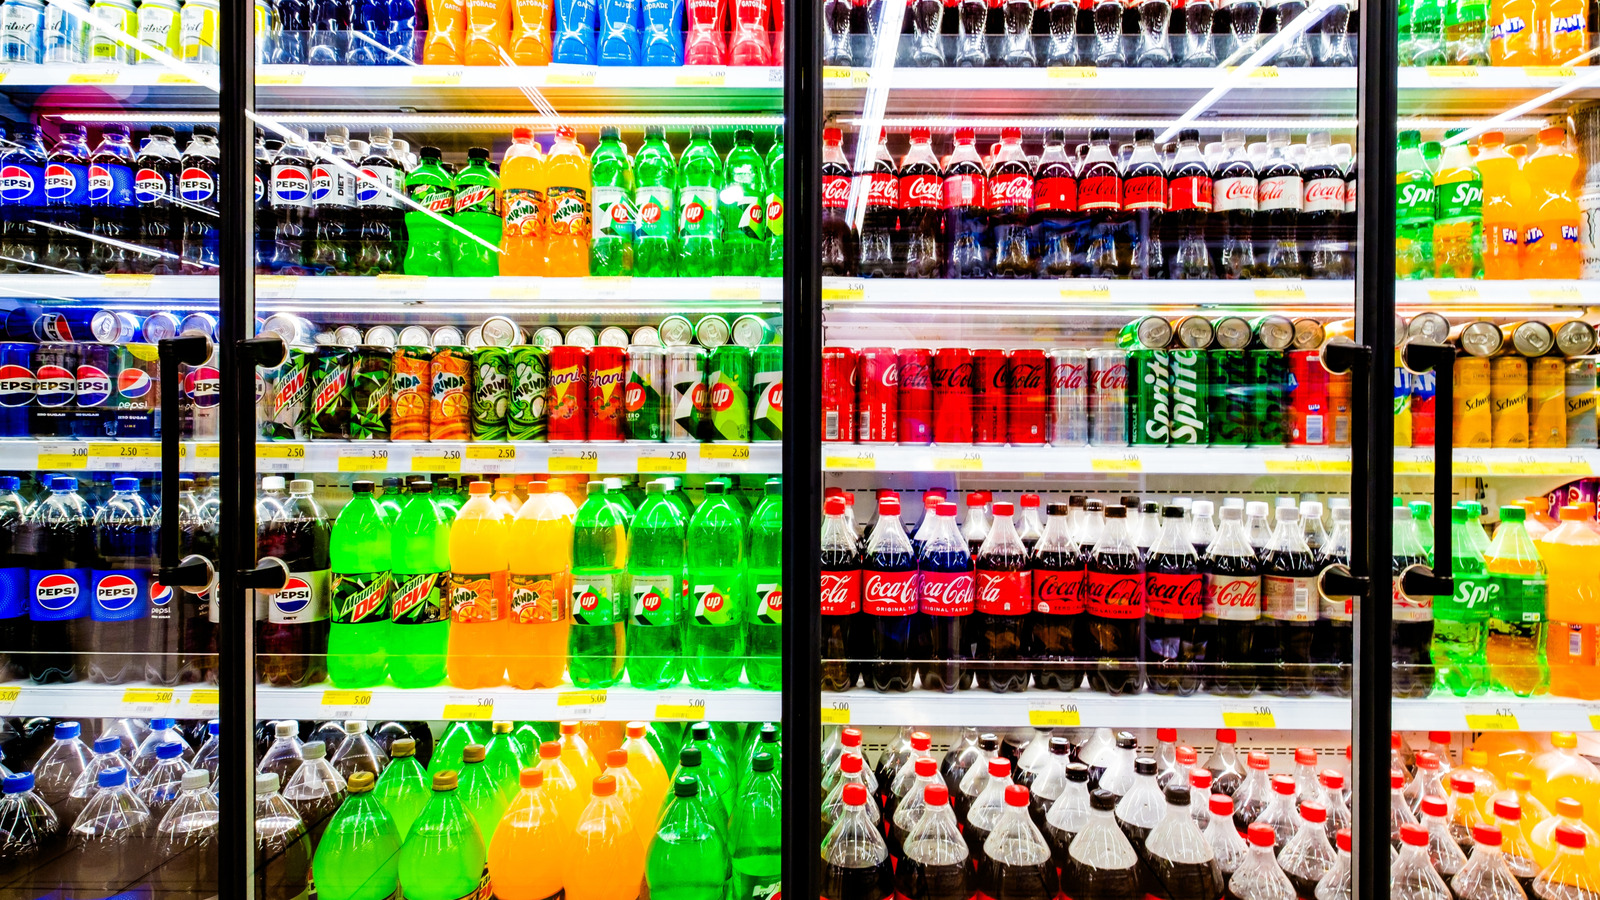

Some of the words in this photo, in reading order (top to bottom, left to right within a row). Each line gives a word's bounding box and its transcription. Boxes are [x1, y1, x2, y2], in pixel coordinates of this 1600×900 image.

[276, 180, 308, 190] PEPSI
[506, 202, 539, 225] MIRINDA
[553, 201, 584, 223] MIRINDA
[77, 381, 108, 391] EPSI
[118, 401, 148, 410] pepsi
[72, 448, 88, 457] 3.00
[120, 447, 137, 457] 2.50
[287, 448, 304, 457] 2.50
[372, 450, 388, 459] 3.50
[443, 450, 460, 460] 2.50
[498, 449, 515, 458] 2.50
[580, 451, 597, 460] 2.50
[669, 451, 686, 460] 2.50
[732, 448, 749, 458] 2.50
[857, 452, 874, 460] 2.50
[963, 452, 980, 460] 2.50
[1414, 455, 1432, 463] 2.50
[1464, 455, 1483, 463] 2.50
[38, 587, 77, 596] PEPSI
[99, 587, 135, 597] PEPSI
[275, 591, 309, 599] PEPSI
[1, 692, 18, 700] 5.00
[156, 692, 173, 701] 5.00
[354, 695, 371, 704] 5.00
[590, 694, 607, 703] 5.00
[477, 698, 494, 707] 5.00
[688, 699, 705, 708] 5.00
[832, 702, 849, 711] 5.00
[1060, 704, 1077, 713] 5.00
[1254, 706, 1271, 716] 5.00
[1496, 708, 1513, 717] 4.75
